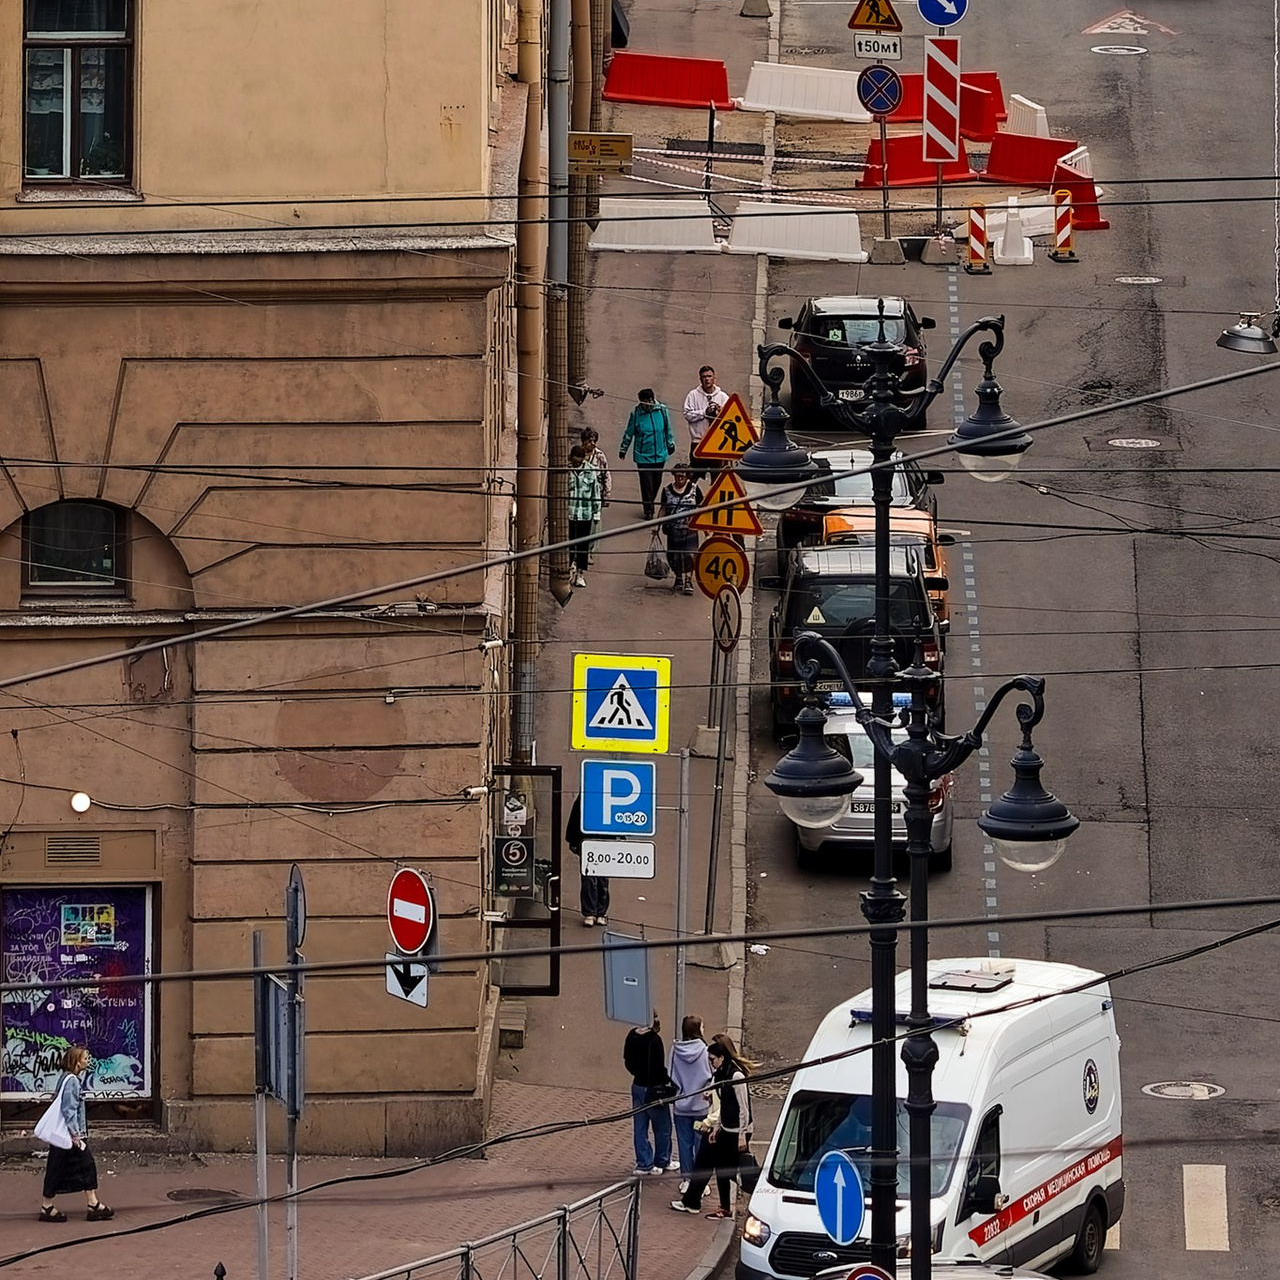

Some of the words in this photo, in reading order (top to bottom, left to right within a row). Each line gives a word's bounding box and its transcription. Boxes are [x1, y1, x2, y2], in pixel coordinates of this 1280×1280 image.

[864, 40, 891, 53] 50м
[705, 556, 737, 582] 40
[602, 769, 641, 825] P
[635, 814, 646, 823] 20
[508, 841, 522, 861] 5
[587, 851, 649, 865] 8.00-20.00
[1023, 1187, 1046, 1212] СКОРАЯ
[1046, 1162, 1086, 1196] МЕДИЦИНСКАЯ
[1087, 1148, 1111, 1171] ПОМОЩЬ
